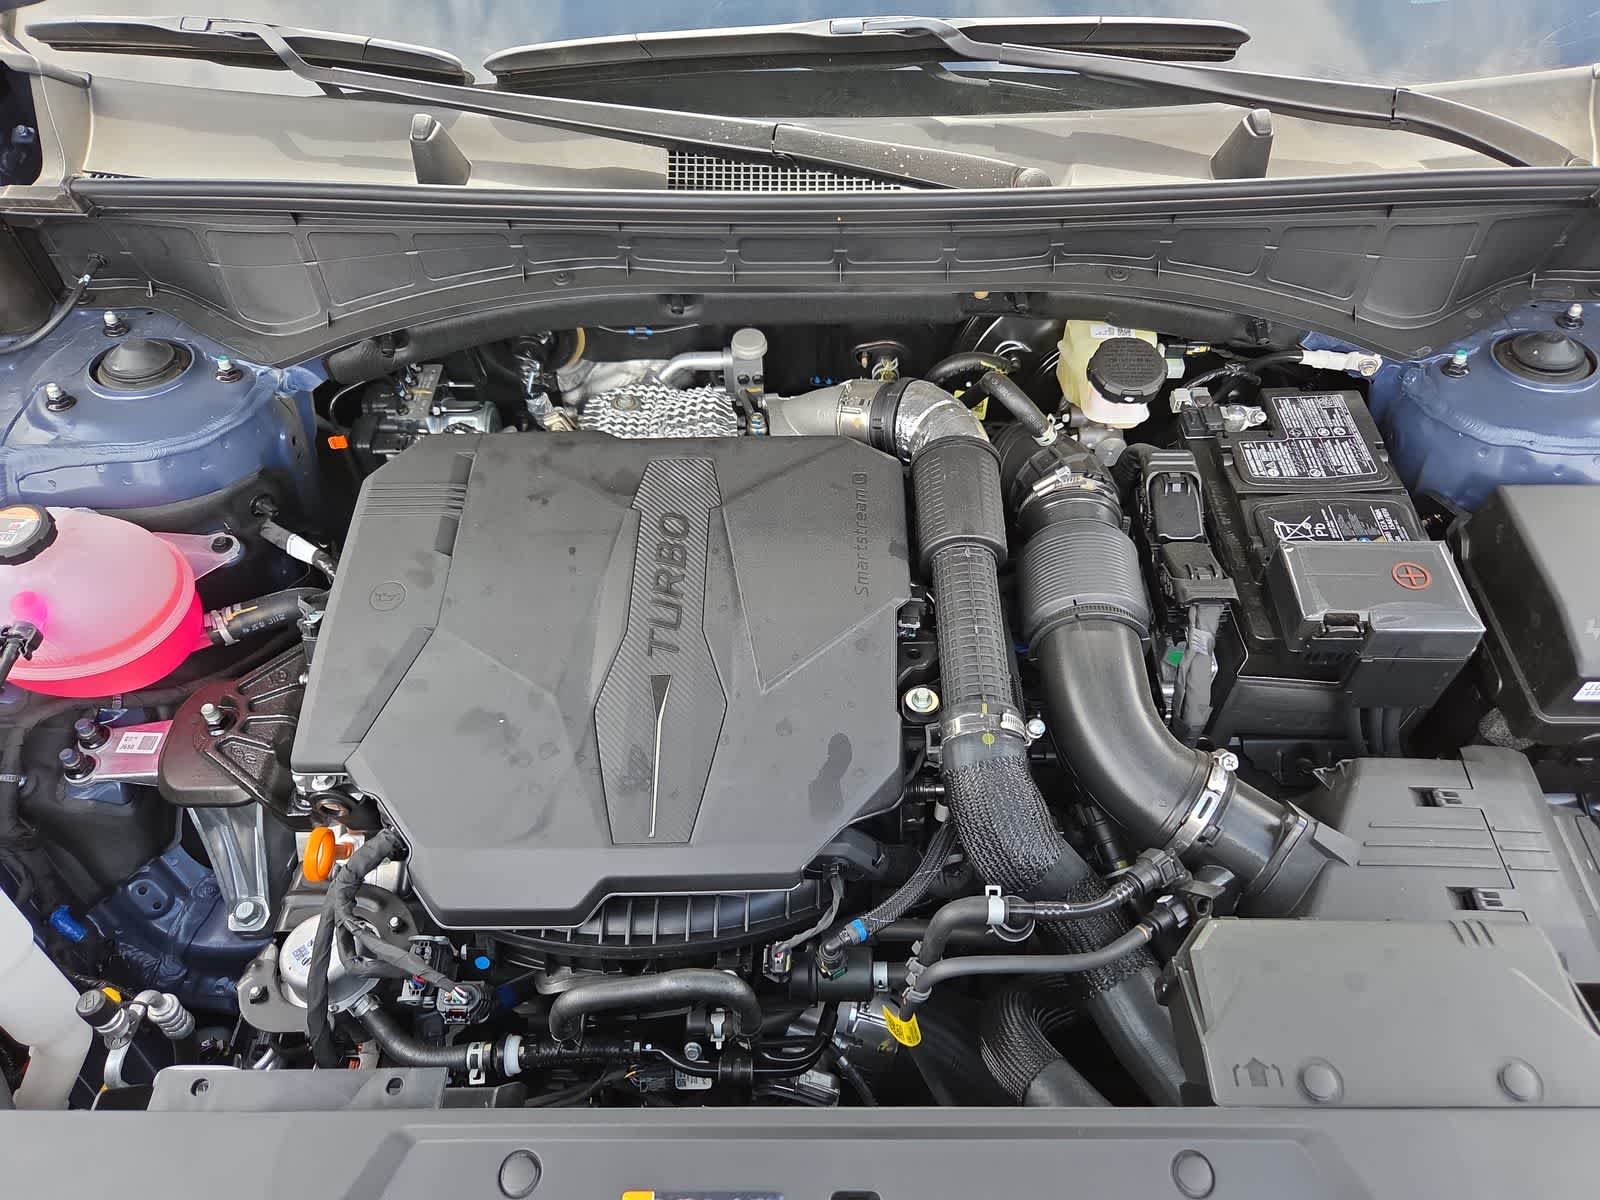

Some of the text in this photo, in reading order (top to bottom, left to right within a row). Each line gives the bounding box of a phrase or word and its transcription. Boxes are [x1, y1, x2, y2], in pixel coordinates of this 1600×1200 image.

[853, 488, 868, 598] Smartstream
[1314, 522, 1329, 537] Pb
[648, 512, 690, 659] TURBO
